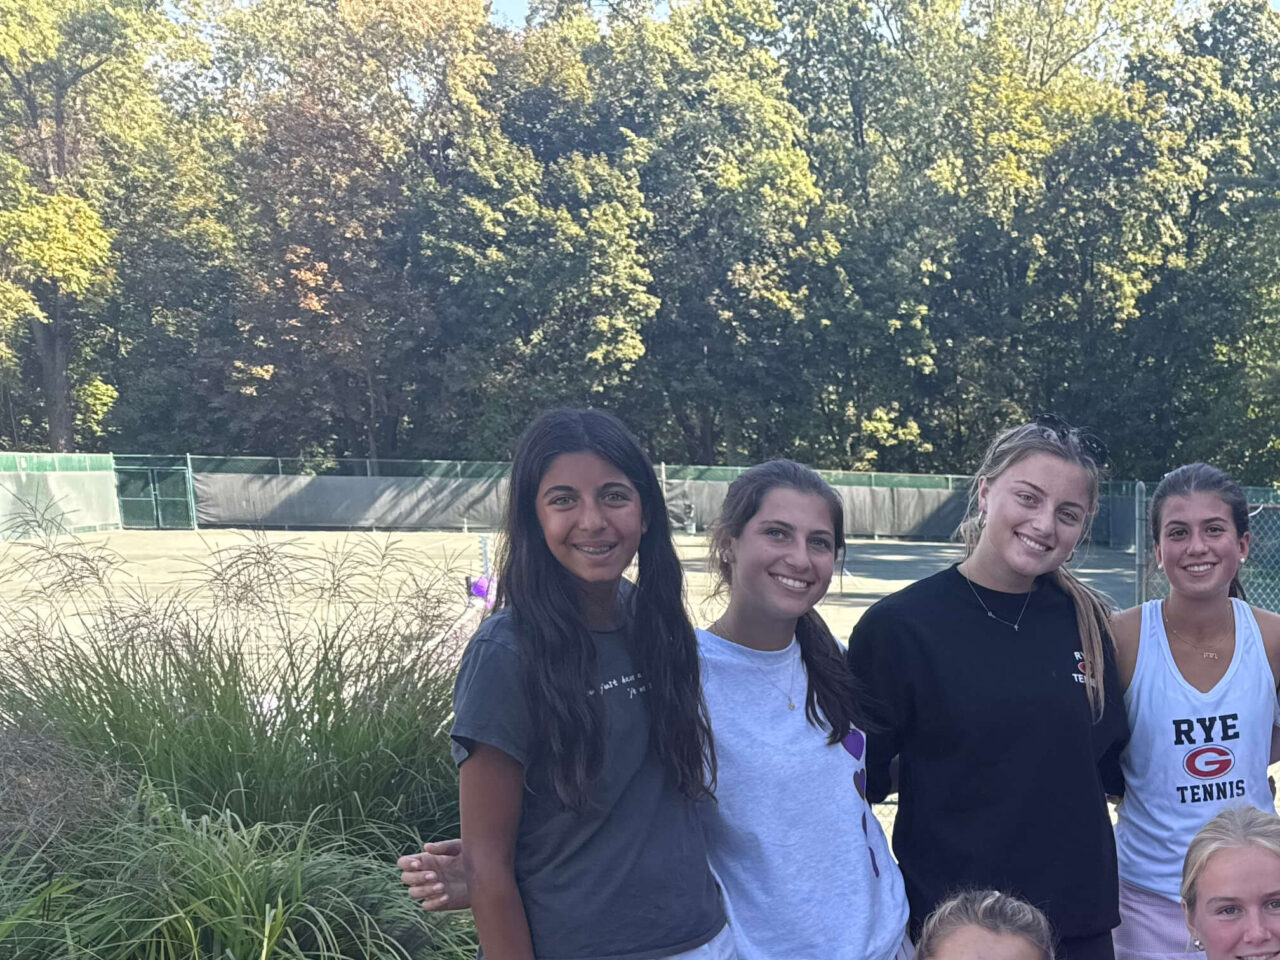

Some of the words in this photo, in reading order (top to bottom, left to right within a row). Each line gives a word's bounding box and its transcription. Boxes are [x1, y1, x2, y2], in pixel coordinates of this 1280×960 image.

[1173, 713, 1240, 745] RYE
[1186, 747, 1232, 777] G
[1176, 779, 1245, 803] TENNIS
